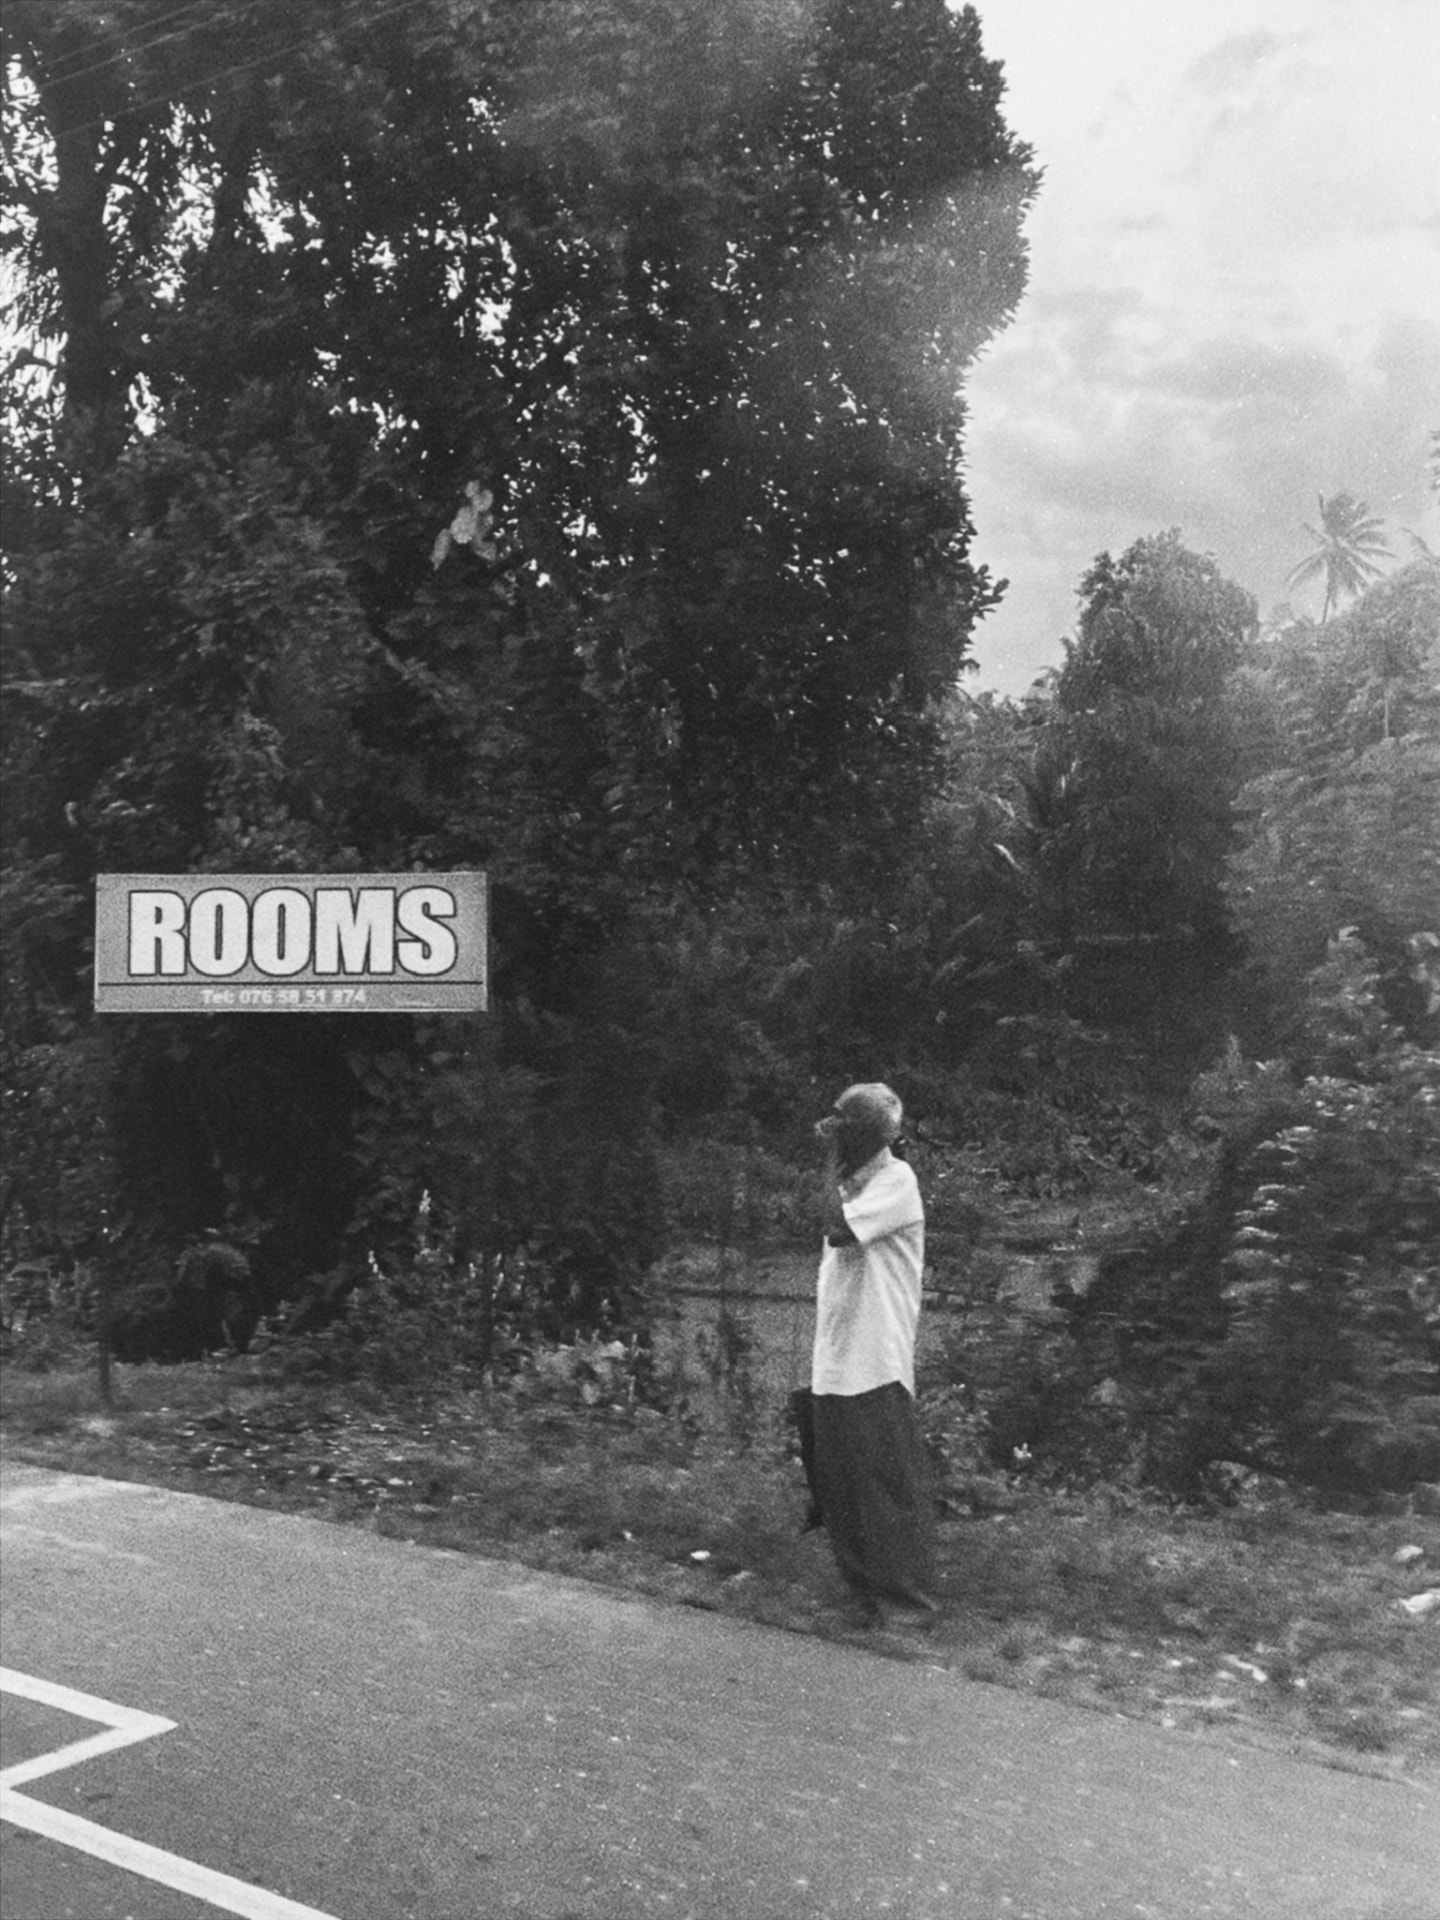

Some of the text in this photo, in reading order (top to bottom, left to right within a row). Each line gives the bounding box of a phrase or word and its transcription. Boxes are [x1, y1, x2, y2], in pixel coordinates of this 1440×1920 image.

[128, 885, 458, 976] ROOMS
[239, 989, 273, 1004] 076
[305, 989, 326, 1004] 51
